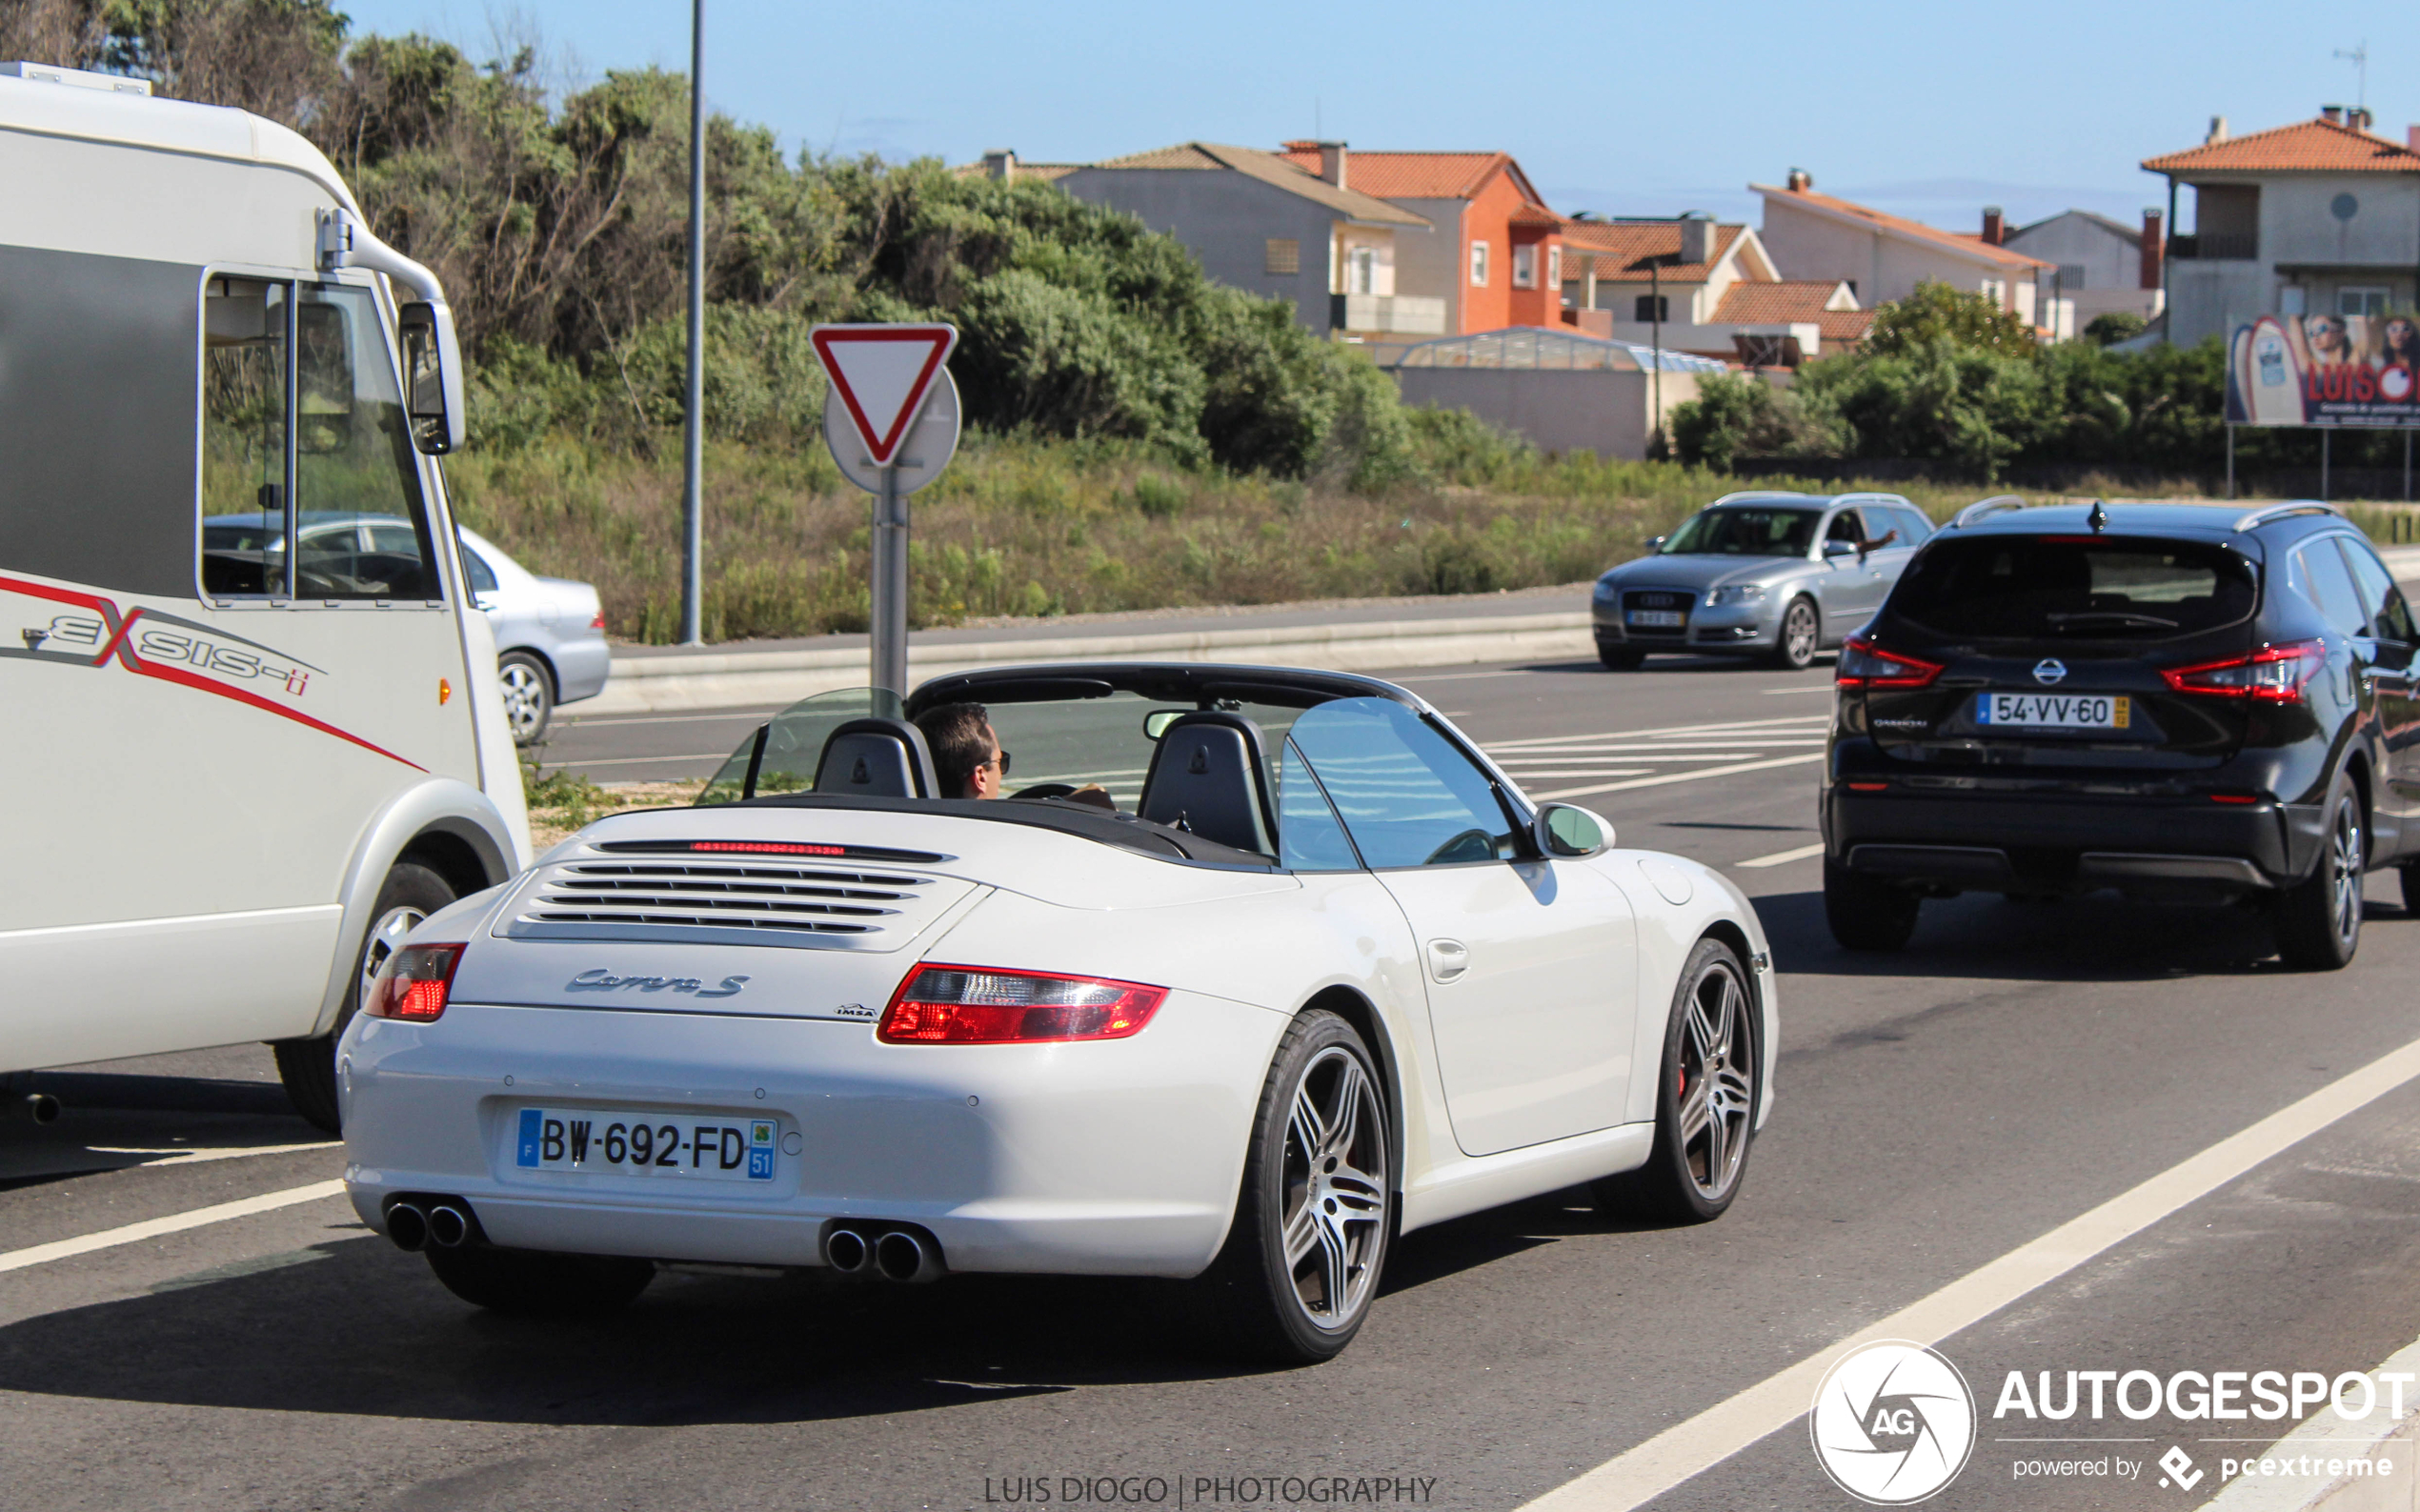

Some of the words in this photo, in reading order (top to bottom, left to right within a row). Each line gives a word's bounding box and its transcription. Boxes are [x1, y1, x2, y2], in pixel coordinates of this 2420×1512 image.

[2309, 363, 2420, 402] LUISO
[573, 968, 703, 990] Carrera
[699, 975, 753, 996] S
[524, 1145, 533, 1158] F
[542, 1119, 745, 1171] BW-692-FD
[752, 1153, 770, 1175] 51
